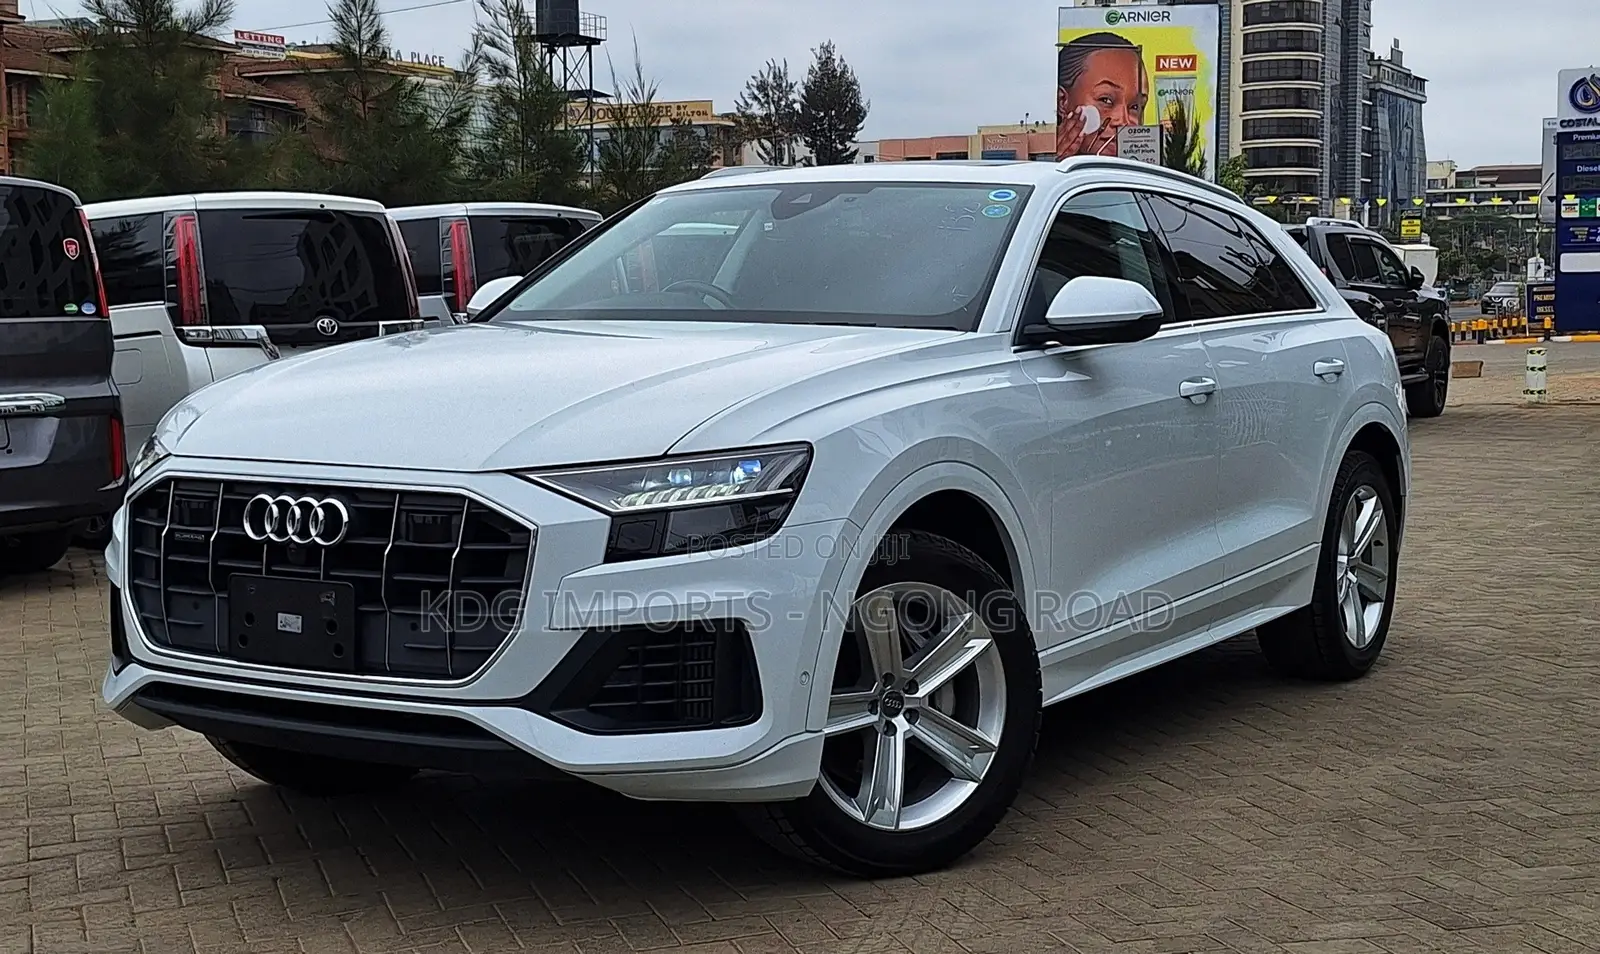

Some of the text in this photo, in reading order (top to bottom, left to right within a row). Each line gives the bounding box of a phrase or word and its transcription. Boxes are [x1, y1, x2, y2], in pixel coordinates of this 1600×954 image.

[1105, 10, 1171, 25] GARNIER
[237, 32, 282, 43] LETTING
[410, 52, 444, 67] PLACE
[1159, 58, 1193, 69] NEW
